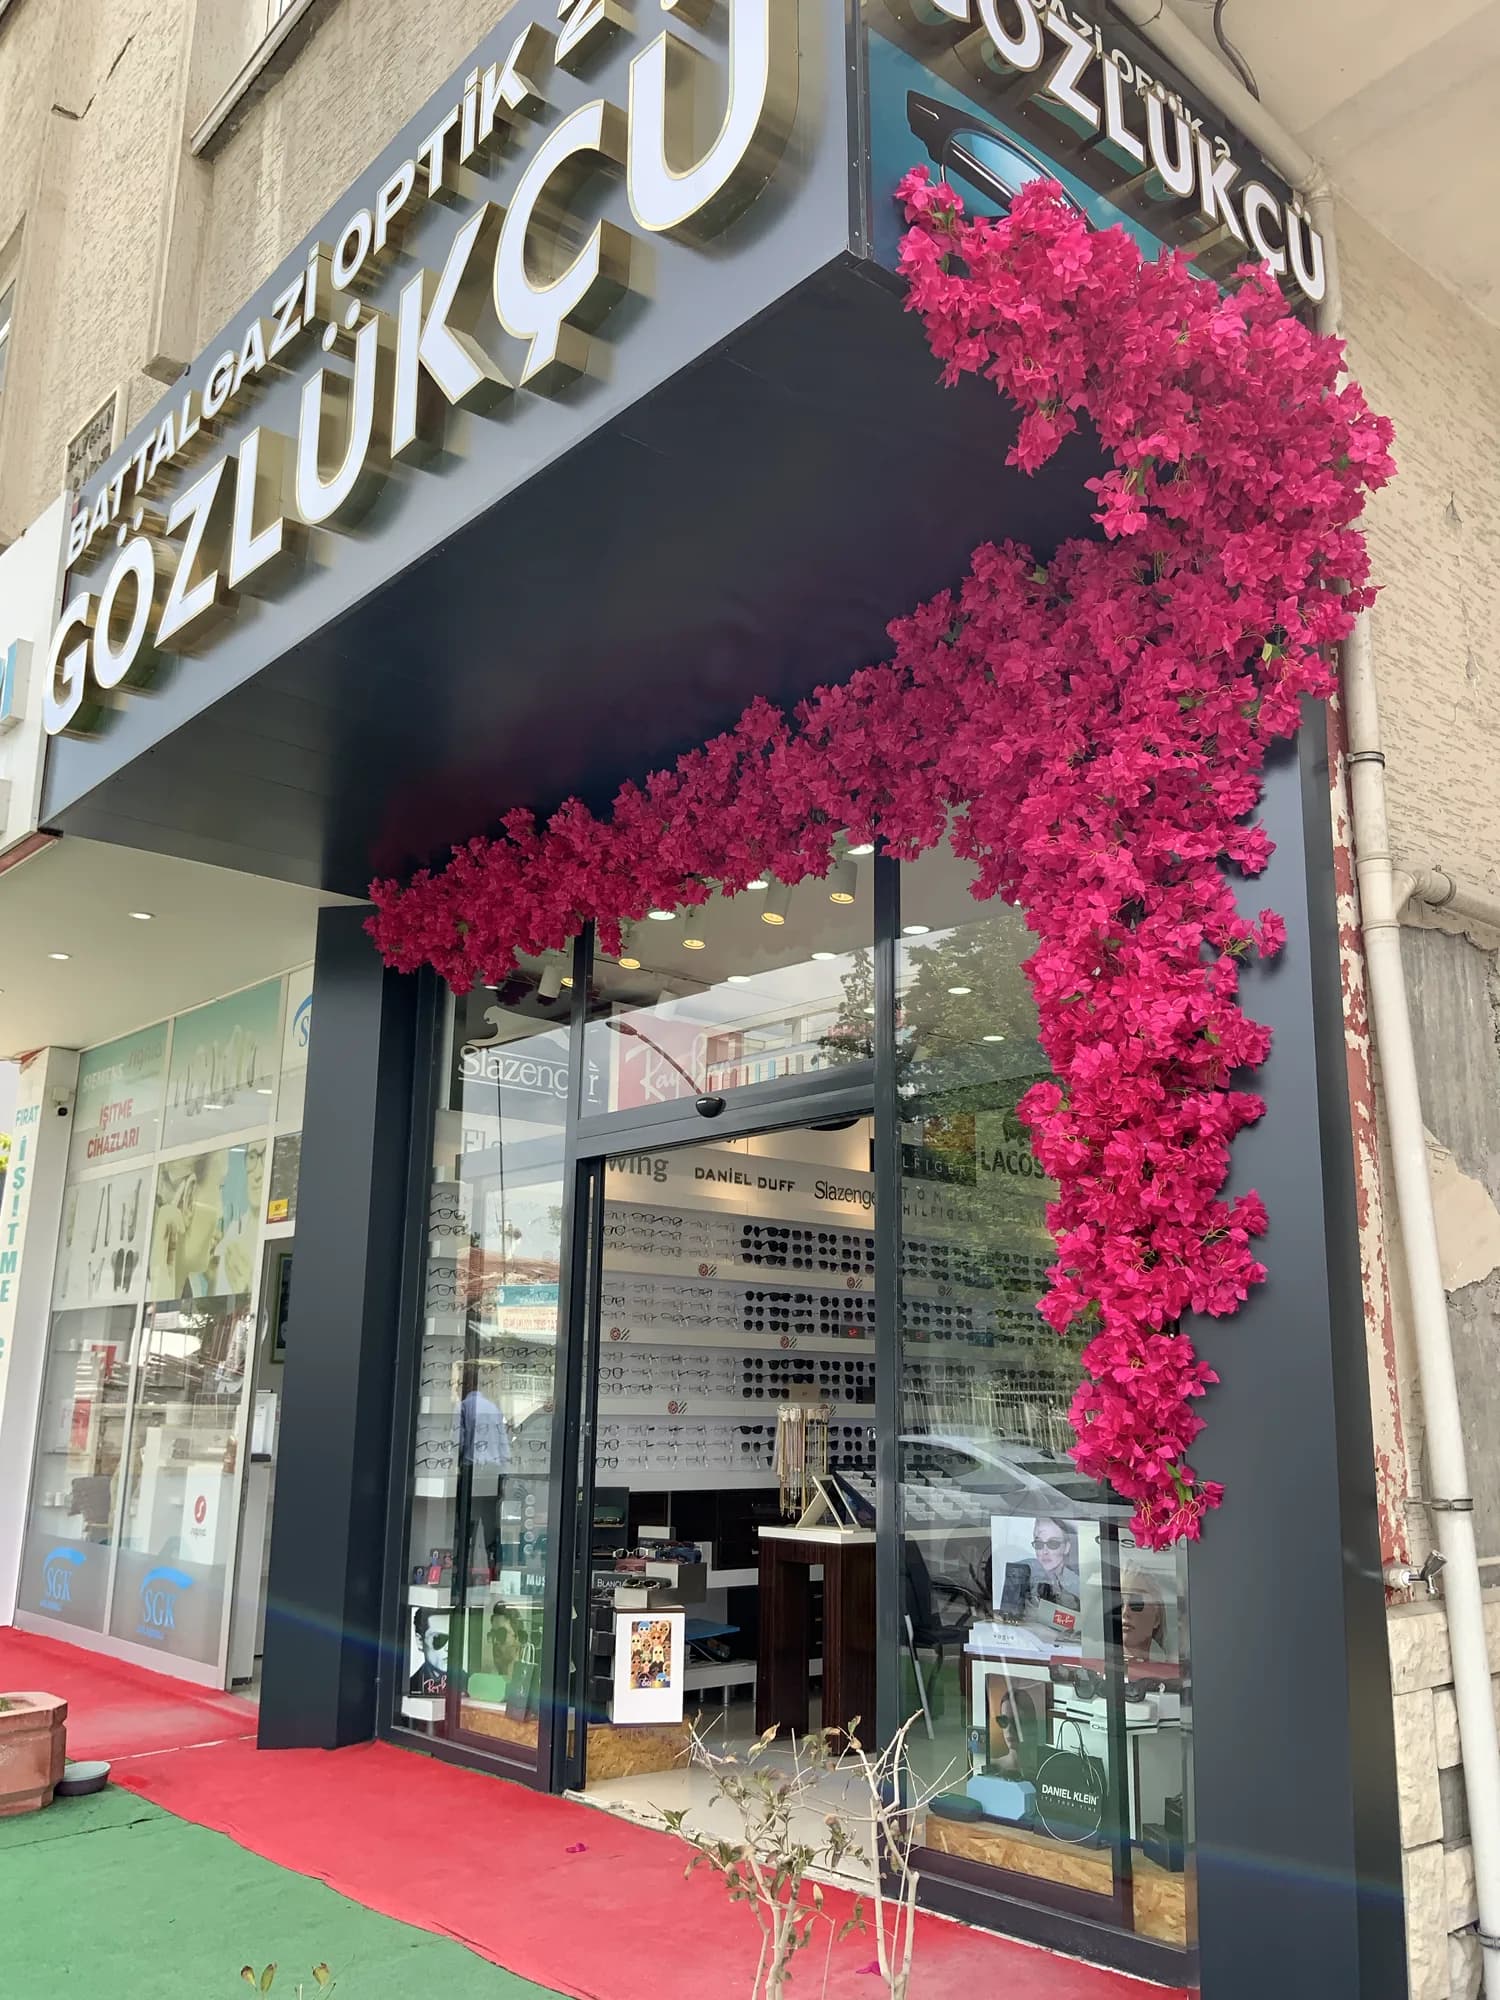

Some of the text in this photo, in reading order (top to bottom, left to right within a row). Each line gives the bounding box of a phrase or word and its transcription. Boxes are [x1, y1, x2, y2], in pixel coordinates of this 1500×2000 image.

[331, 22, 535, 291] OPTİK
[42, 0, 770, 736] GÖZLÜKÇÜ
[458, 1044, 600, 1099] Slazengr
[980, 1147, 1046, 1179] LACOS
[758, 1177, 796, 1193] DUFF
[142, 1588, 178, 1630] SGK
[1042, 1784, 1072, 1800] DANIEL
[1073, 1791, 1097, 1806] KLEIN
